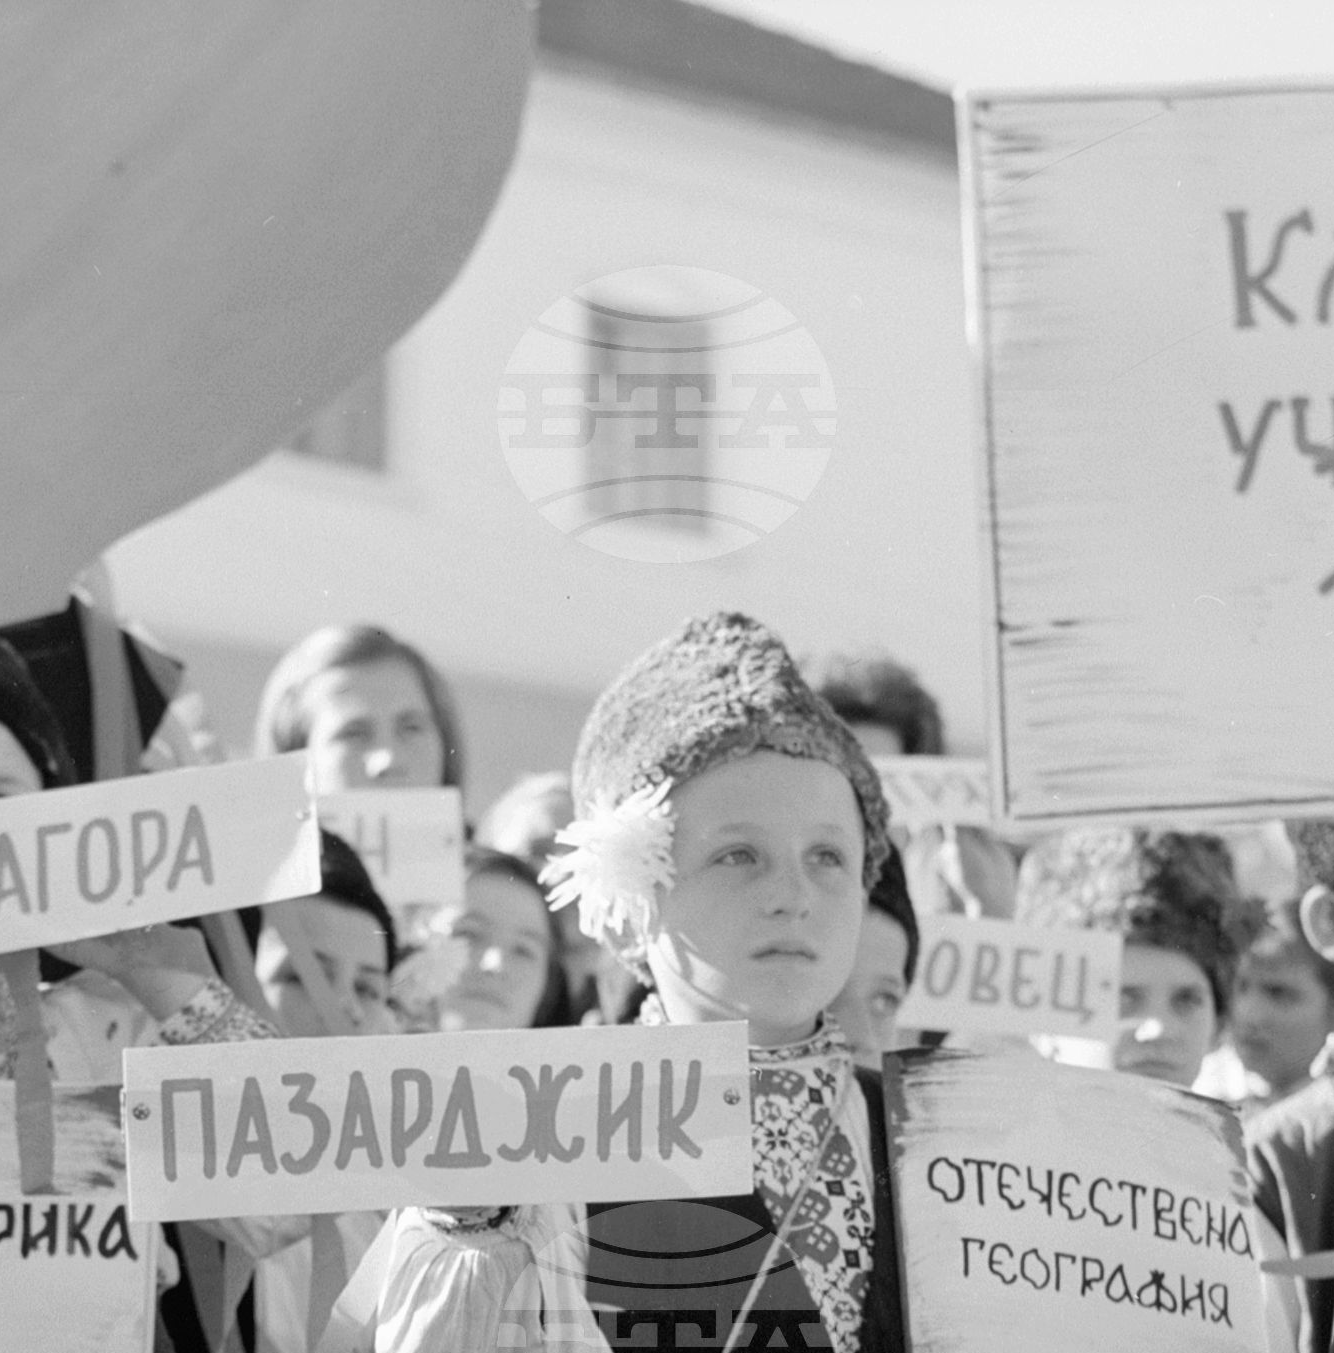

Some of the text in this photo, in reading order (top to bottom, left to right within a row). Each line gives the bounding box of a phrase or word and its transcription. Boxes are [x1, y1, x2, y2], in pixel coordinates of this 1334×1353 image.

[160, 1058, 703, 1182] ПАЗАРДЖИК
[926, 1156, 1254, 1261] ОТЕЧЕСТВЕНА
[960, 1236, 1234, 1329] ГЕОГРАФИЯ
